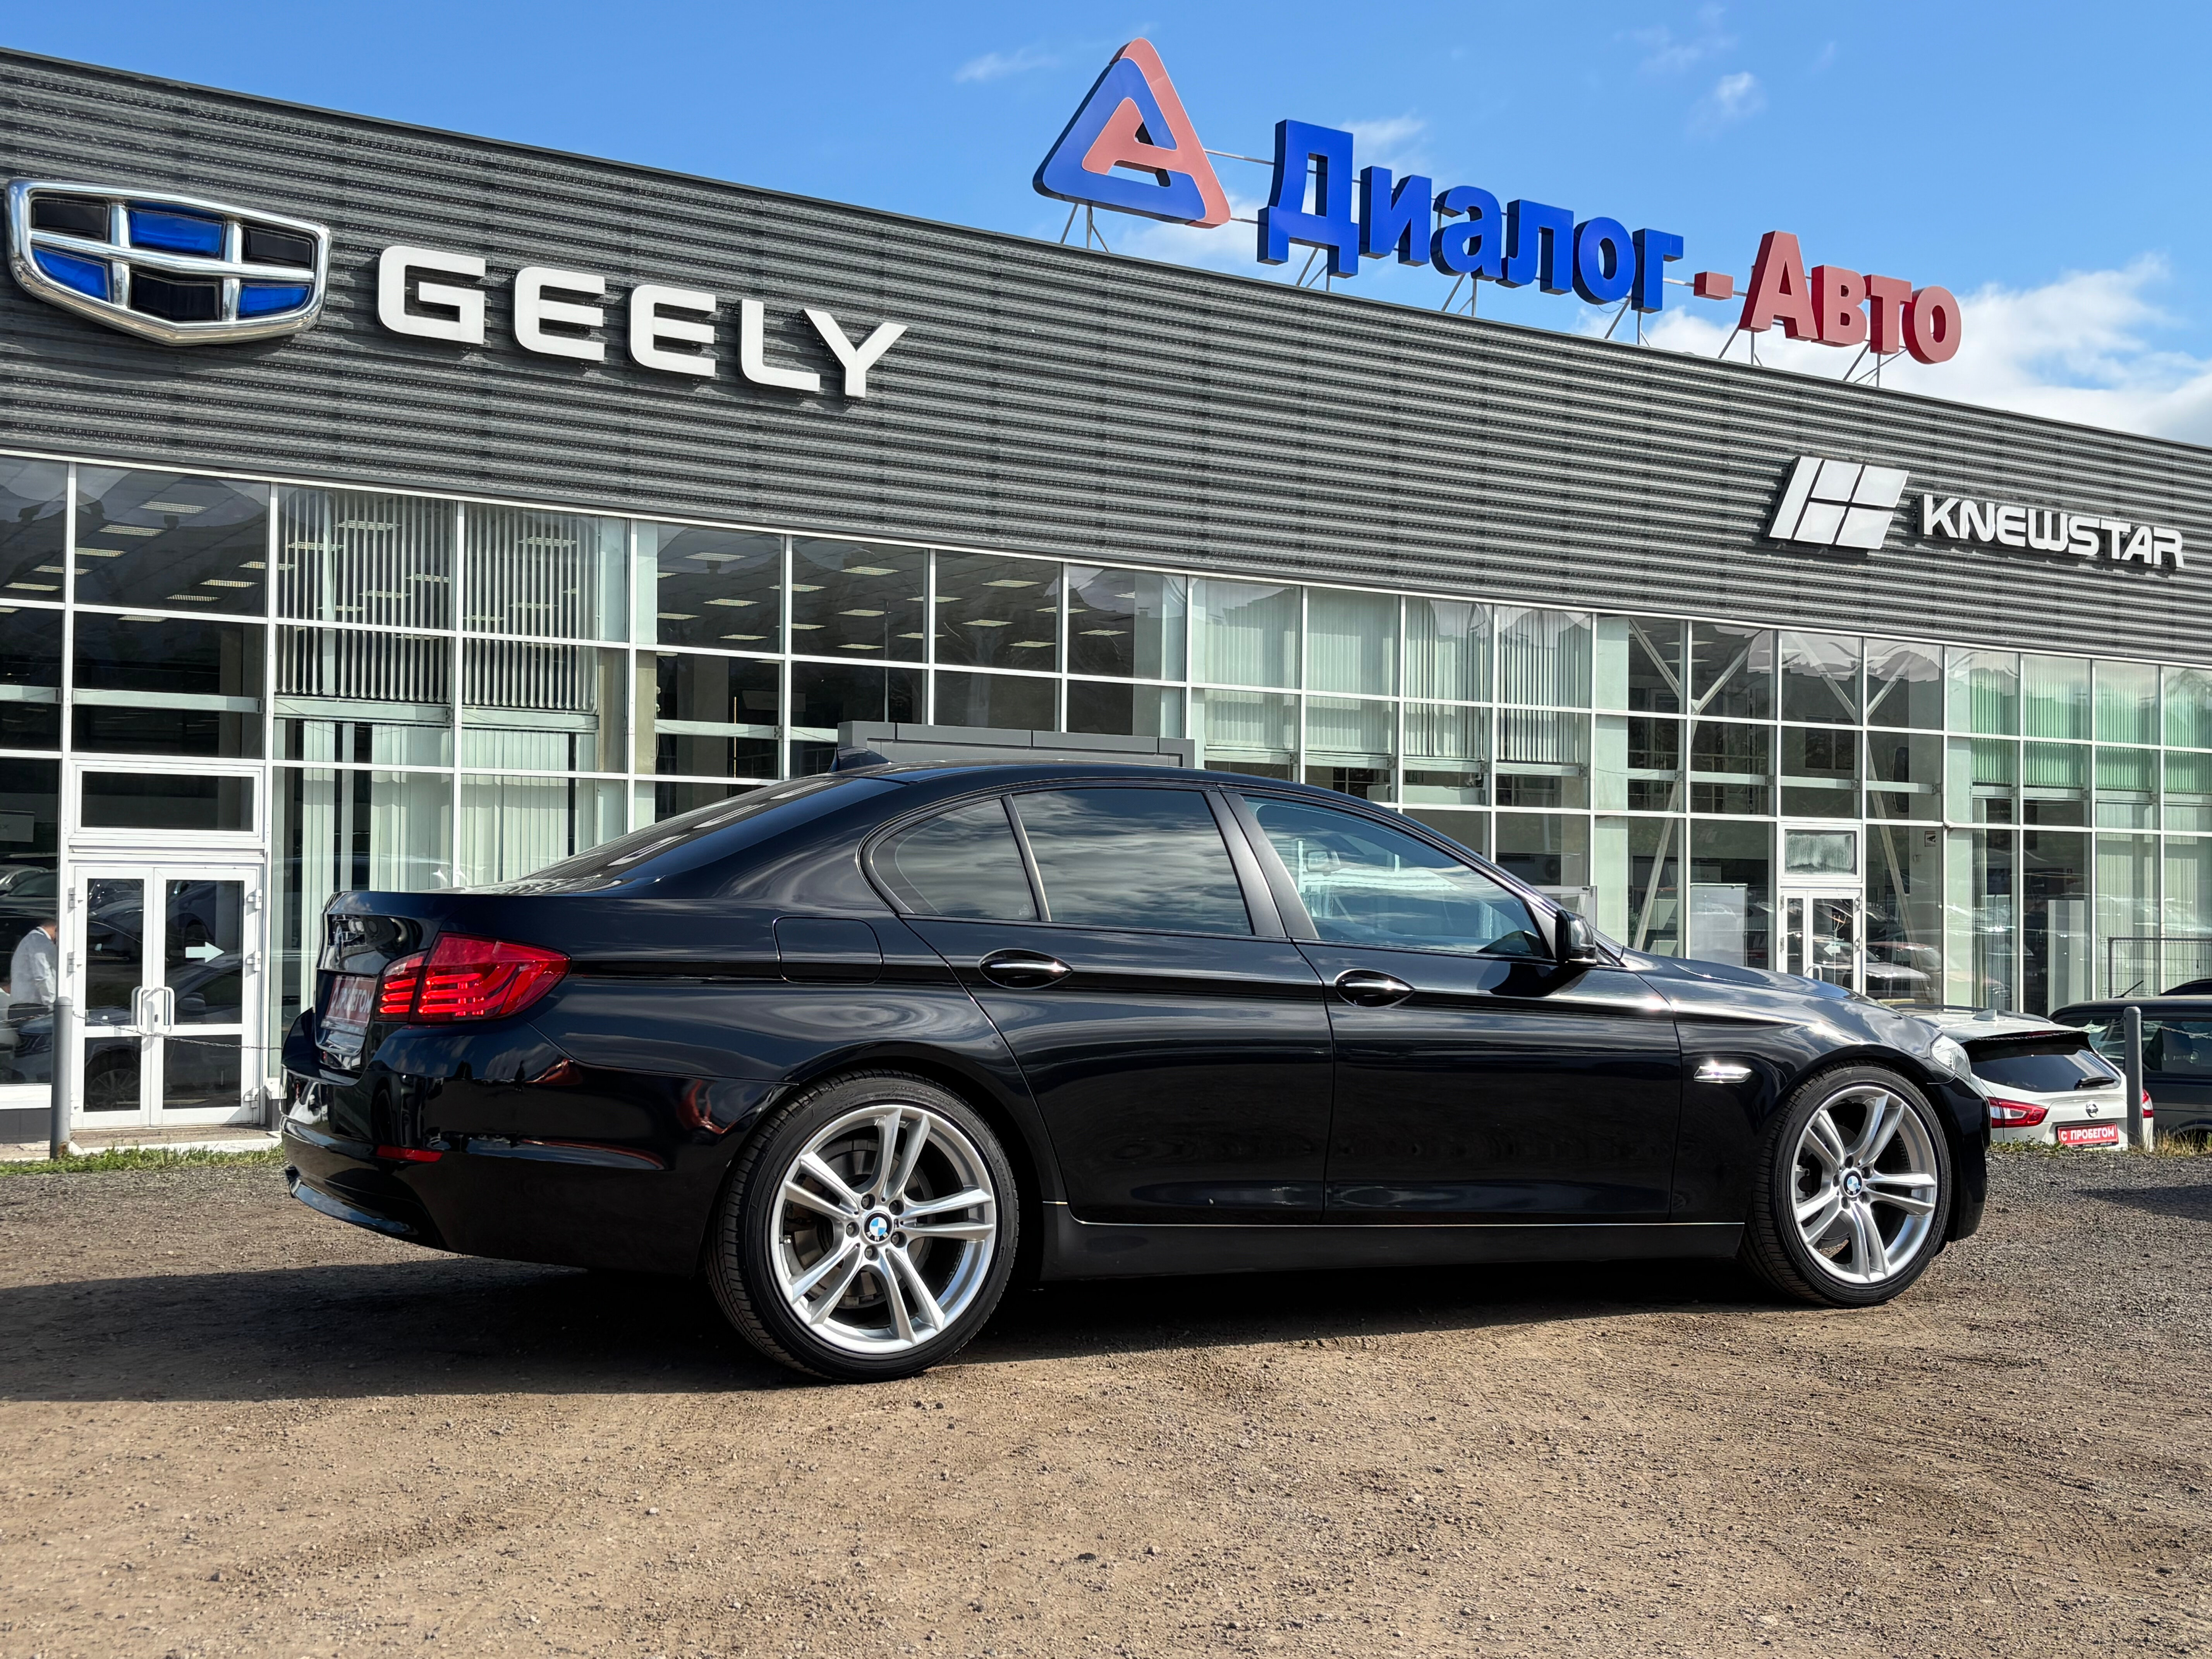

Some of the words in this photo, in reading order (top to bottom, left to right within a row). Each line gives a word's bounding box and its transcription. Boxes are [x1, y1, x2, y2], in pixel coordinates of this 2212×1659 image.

[376, 245, 907, 399] GEELY
[1919, 494, 2185, 568] KNEWSTAR
[2061, 1131, 2068, 1141] С
[2070, 1127, 2114, 1140] ПРОБЕГОМ
